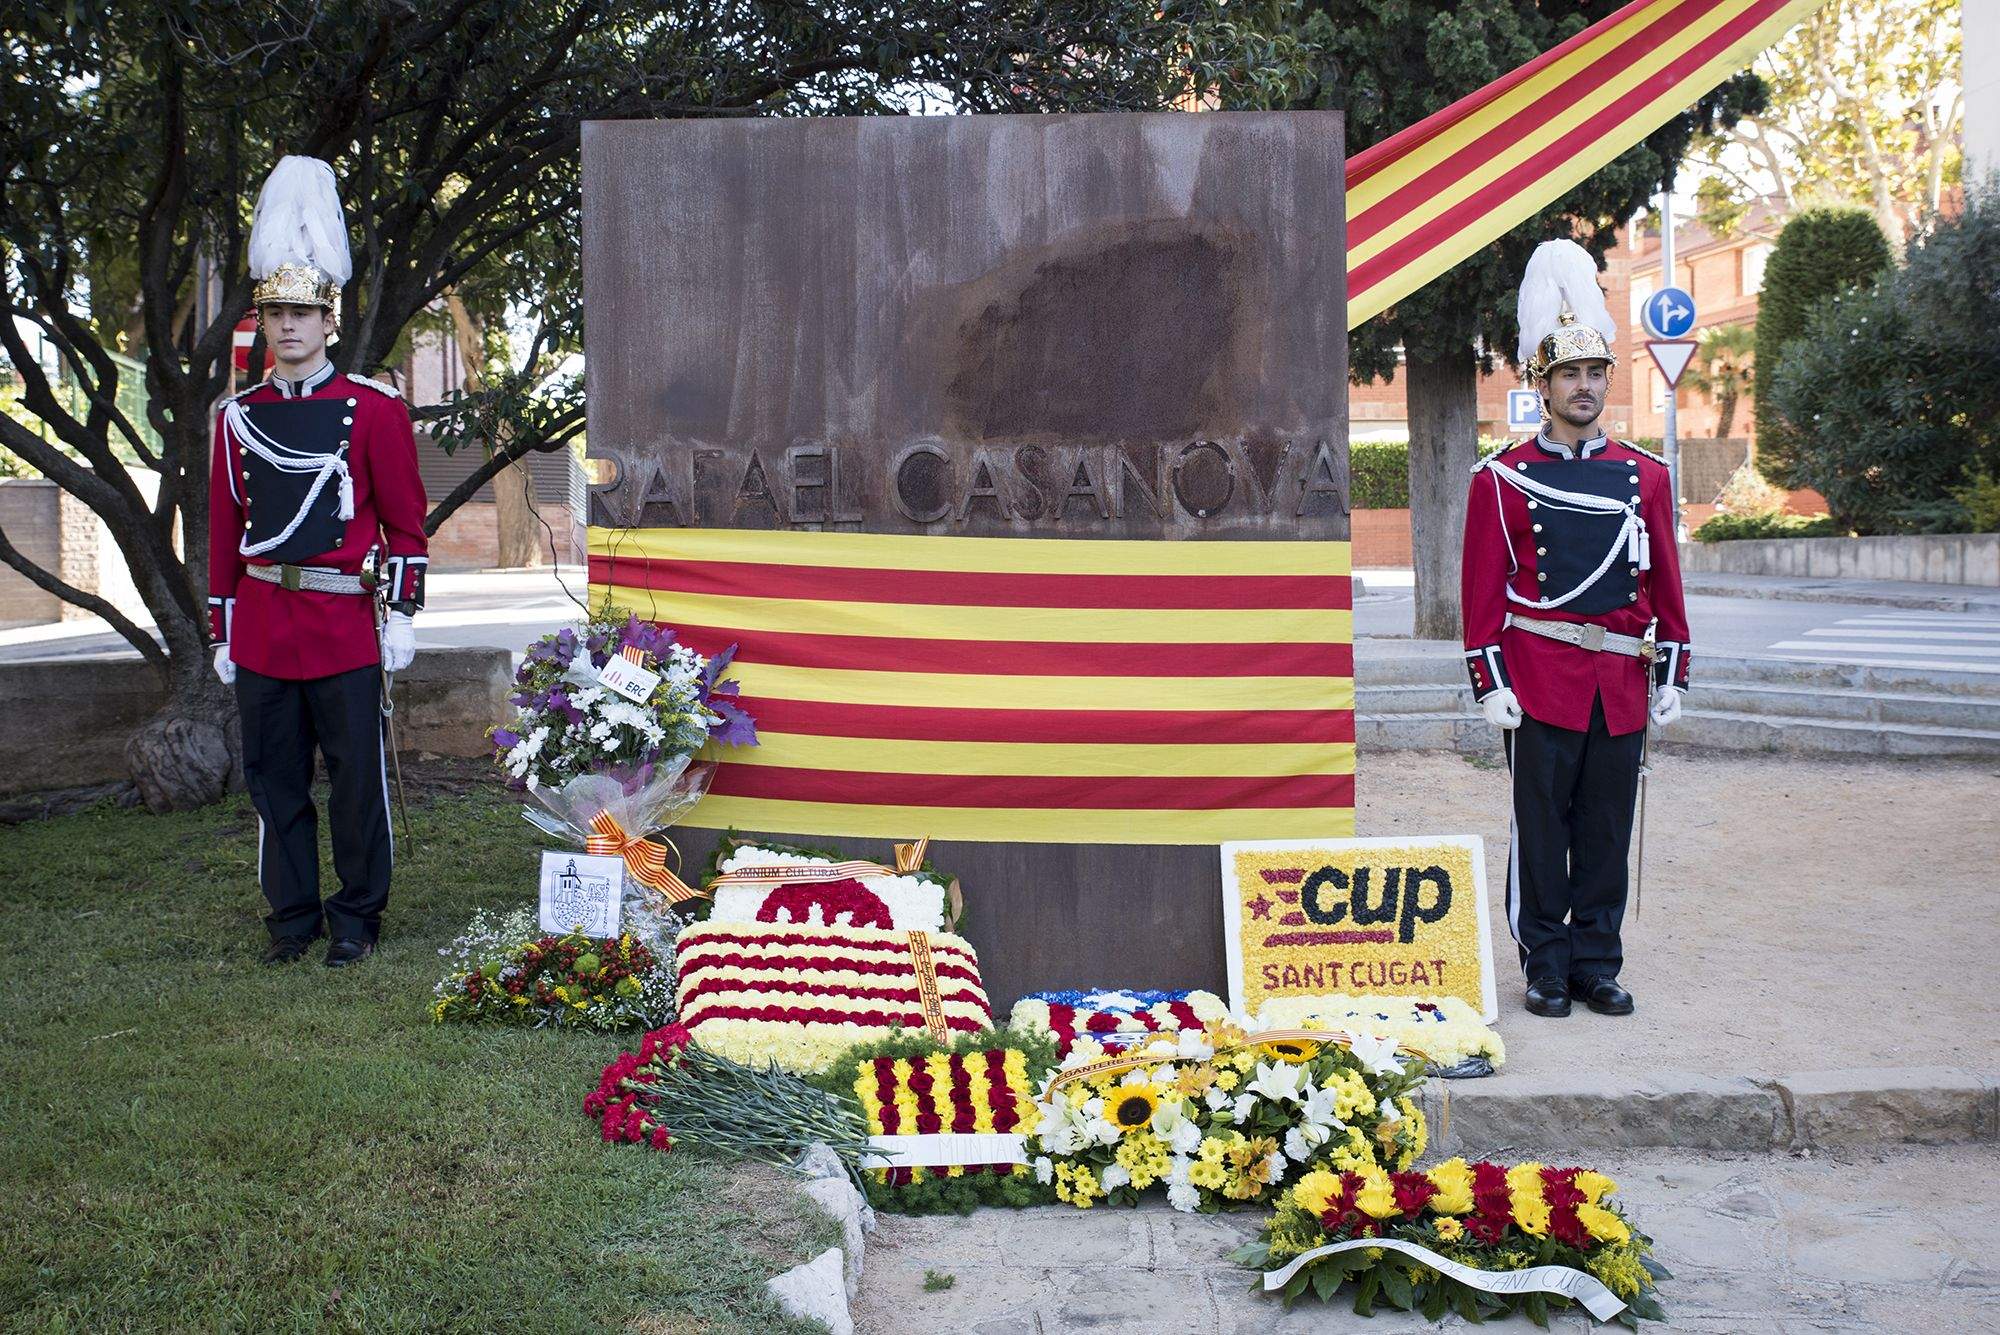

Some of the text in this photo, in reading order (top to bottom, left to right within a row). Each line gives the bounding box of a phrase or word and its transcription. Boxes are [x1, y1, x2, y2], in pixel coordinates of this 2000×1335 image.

[1516, 394, 1537, 422] P
[586, 440, 1350, 527] RAFAEL CASANOVA
[625, 681, 647, 697] ERC
[736, 868, 841, 878] OMNIUM CULTURAL
[1262, 959, 1447, 991] SANT CUGAT
[1477, 1269, 1534, 1290] SANT
